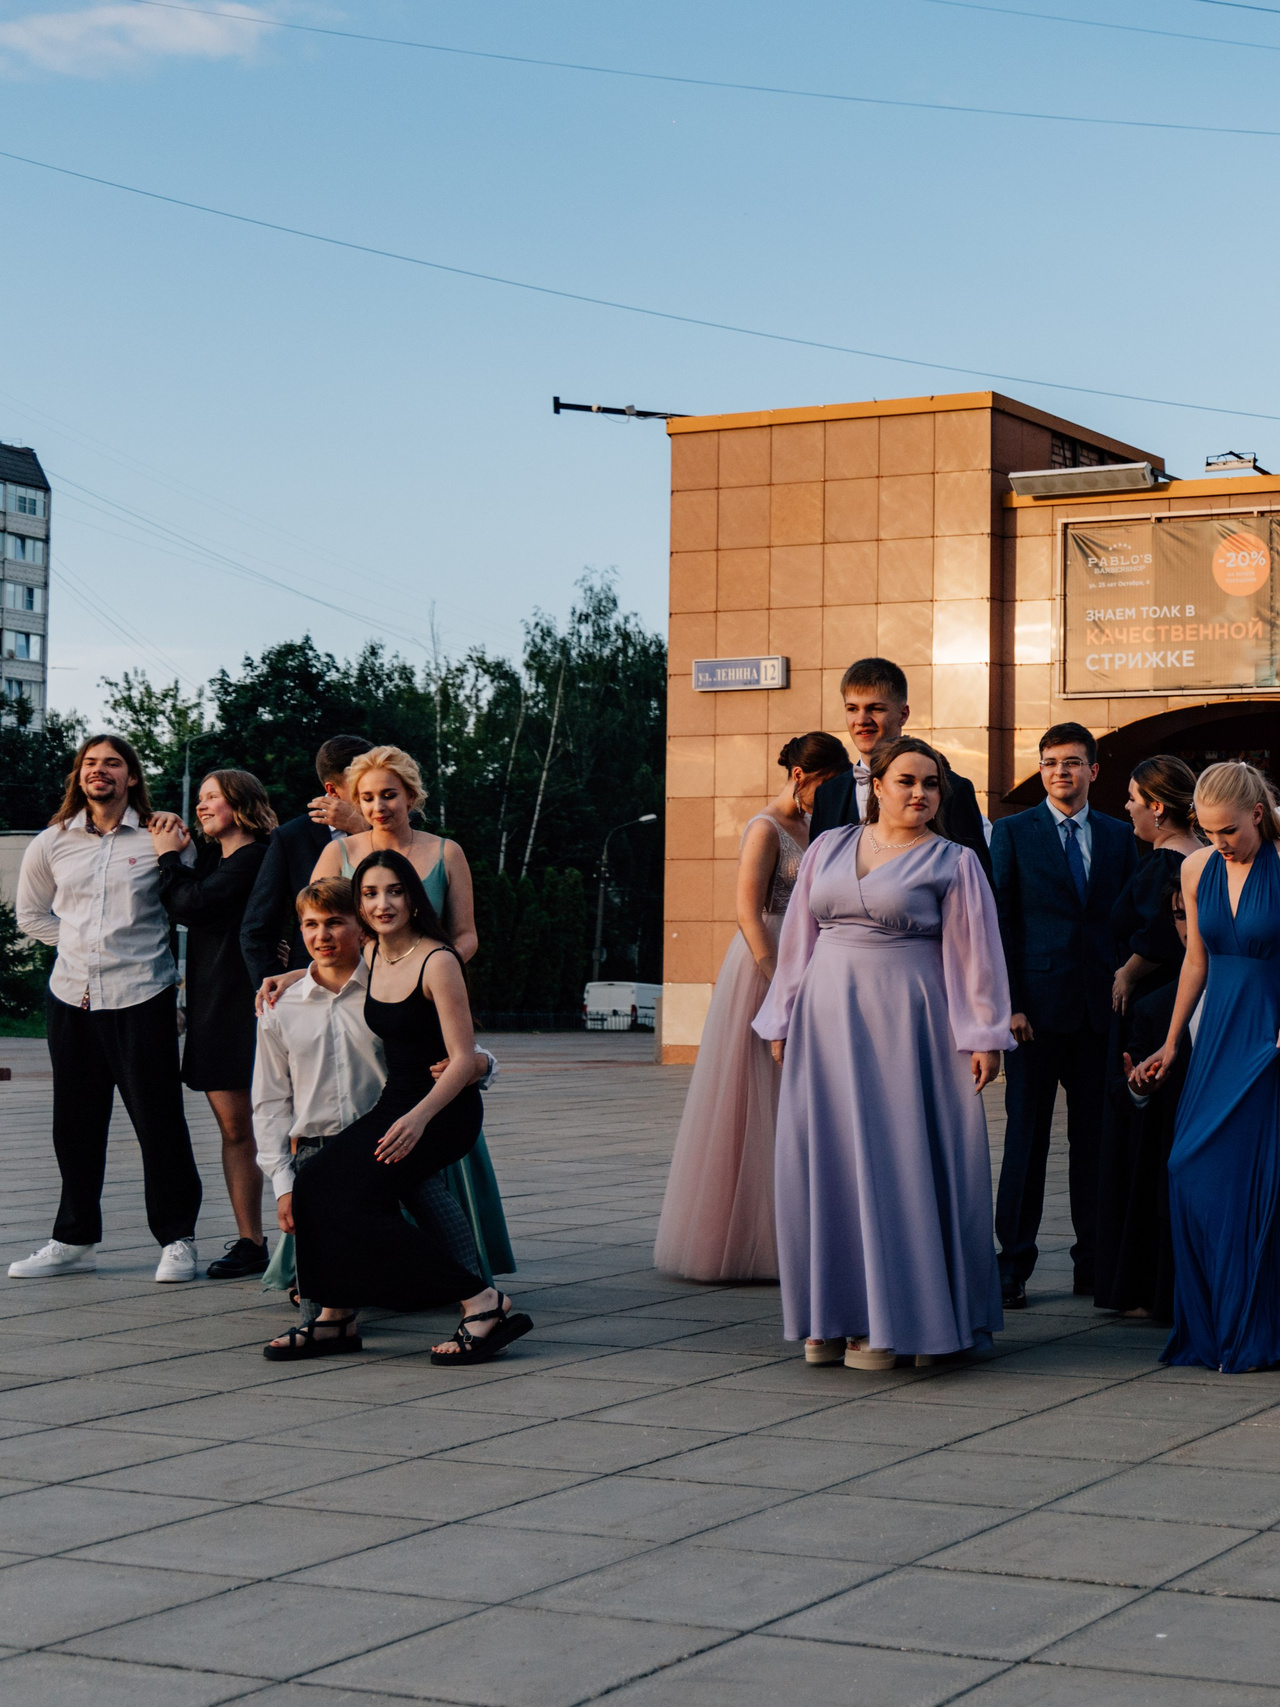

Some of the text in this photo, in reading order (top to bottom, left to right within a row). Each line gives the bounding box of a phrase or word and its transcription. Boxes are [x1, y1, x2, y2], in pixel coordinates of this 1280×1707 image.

[1087, 553, 1153, 567] PABLO'S
[1218, 551, 1266, 567] -20%
[1094, 565, 1146, 574] BARBERSHOP
[1086, 605, 1195, 622] ЗНАЕМ ТОЛК В
[1086, 617, 1263, 645] КАЧЕСТВЕННОЙ
[1086, 651, 1195, 671] СТРИЖКЕ
[713, 667, 758, 681] ЛЕНИНА
[763, 664, 776, 681] 12
